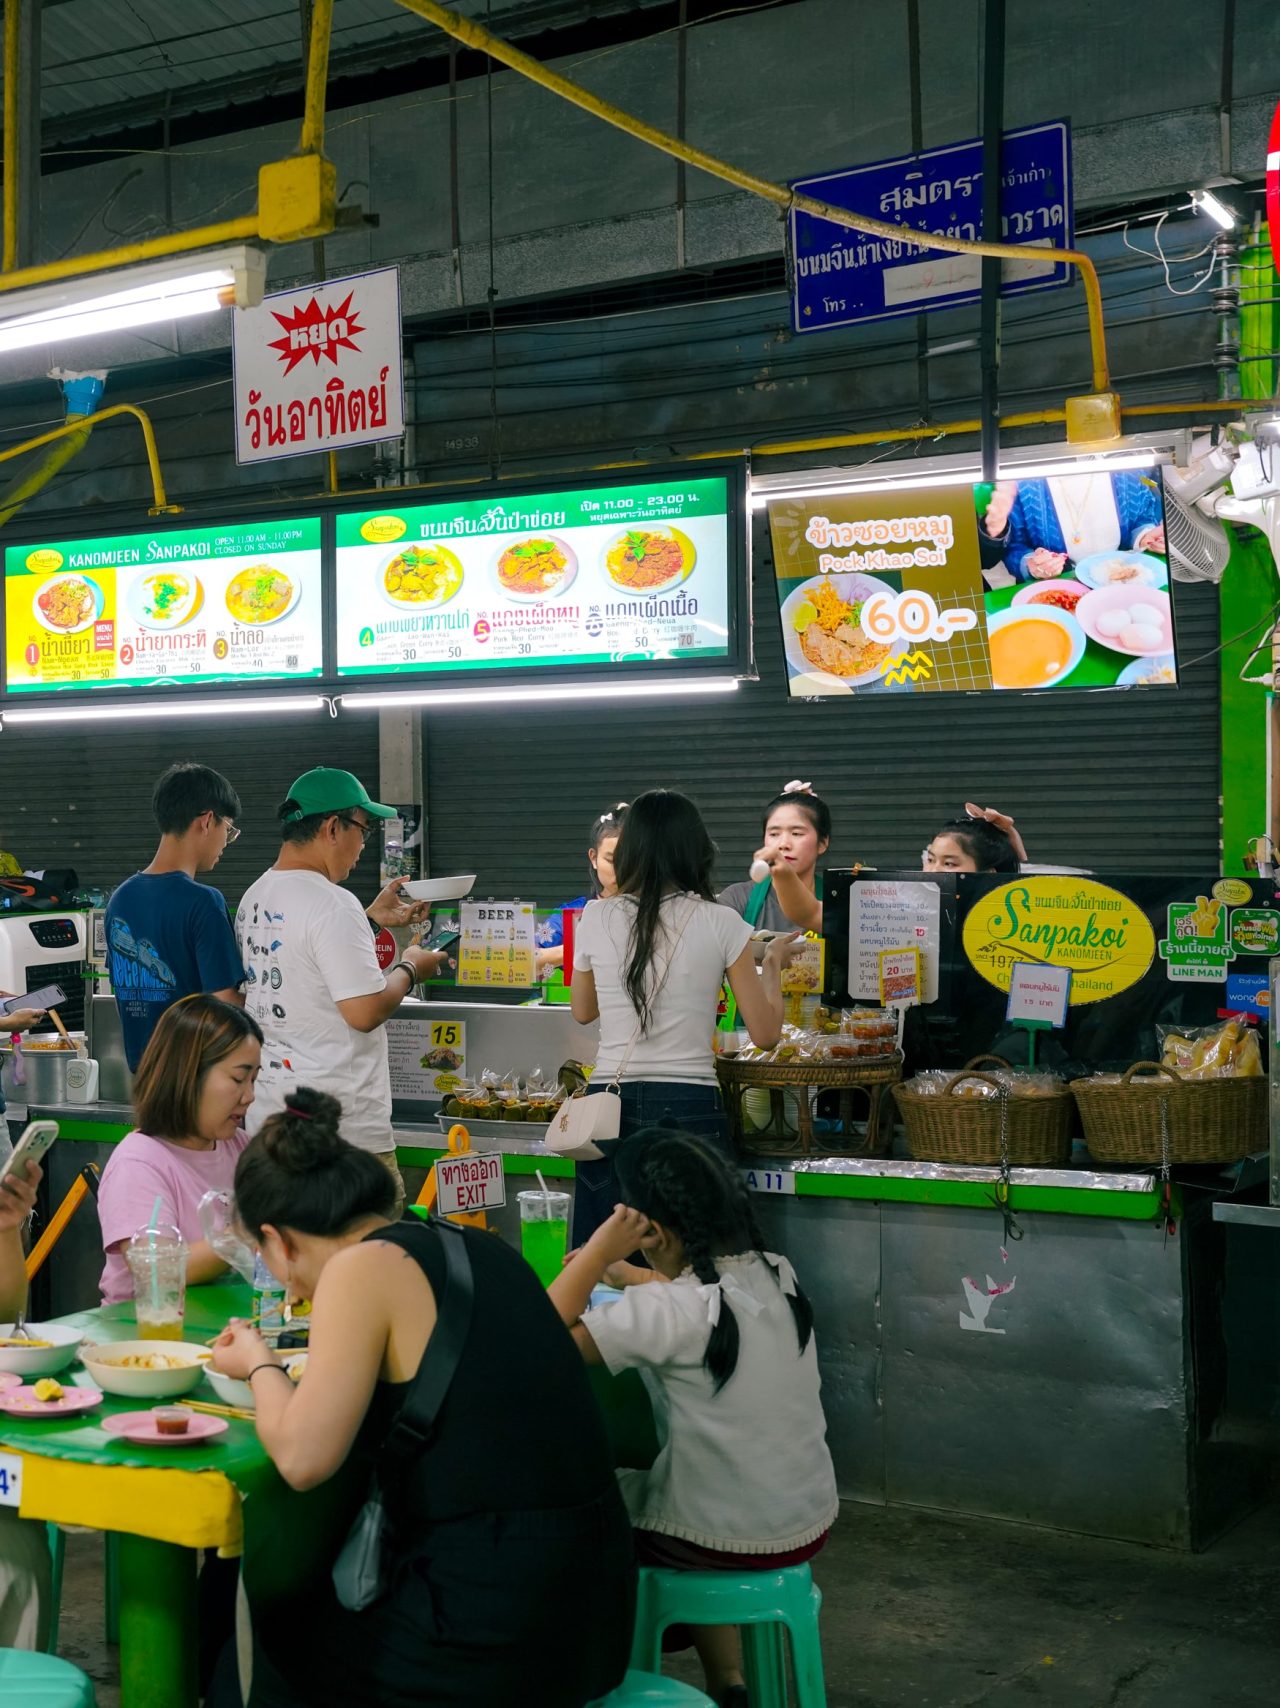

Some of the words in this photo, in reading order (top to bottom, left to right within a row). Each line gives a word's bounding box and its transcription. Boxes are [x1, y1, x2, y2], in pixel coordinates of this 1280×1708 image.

[289, 318, 348, 351] หยุด
[245, 365, 389, 449] วันอาทิตย์
[580, 498, 602, 513] เปิด
[604, 499, 634, 510] 11.00
[647, 493, 684, 506] 23.00
[809, 516, 950, 546] ข้าวซอยหมู
[214, 536, 235, 546] OPEN
[255, 533, 267, 543] AM
[214, 545, 242, 555] CLOSED
[244, 543, 255, 553] ON
[257, 541, 287, 551] SUNDAY
[69, 548, 140, 568] KANOMJEEN
[821, 552, 864, 572] Pock
[867, 550, 913, 569] Khao
[916, 547, 946, 566] Soi
[634, 636, 648, 647] 50
[680, 634, 693, 646] 70
[403, 648, 416, 660] 30
[448, 646, 462, 658] 50
[518, 643, 531, 654] 30
[287, 655, 298, 666] 60
[72, 670, 80, 680] 30
[101, 668, 109, 678] 50
[156, 664, 167, 674] 30
[190, 662, 201, 673] 50
[478, 909, 515, 920] BEER
[987, 887, 1129, 959] Sanpakoi
[1057, 948, 1112, 961] KANOMJEEN
[1166, 940, 1230, 956] ร้านนี้ขายดี
[886, 966, 899, 976] 20
[1172, 968, 1195, 976] LINE
[1198, 968, 1223, 977] MAN
[1070, 977, 1113, 991] hailand
[441, 1159, 499, 1185] ทางออก
[746, 1171, 758, 1188] A
[765, 1172, 782, 1190] 11
[456, 1183, 487, 1206] EXIT
